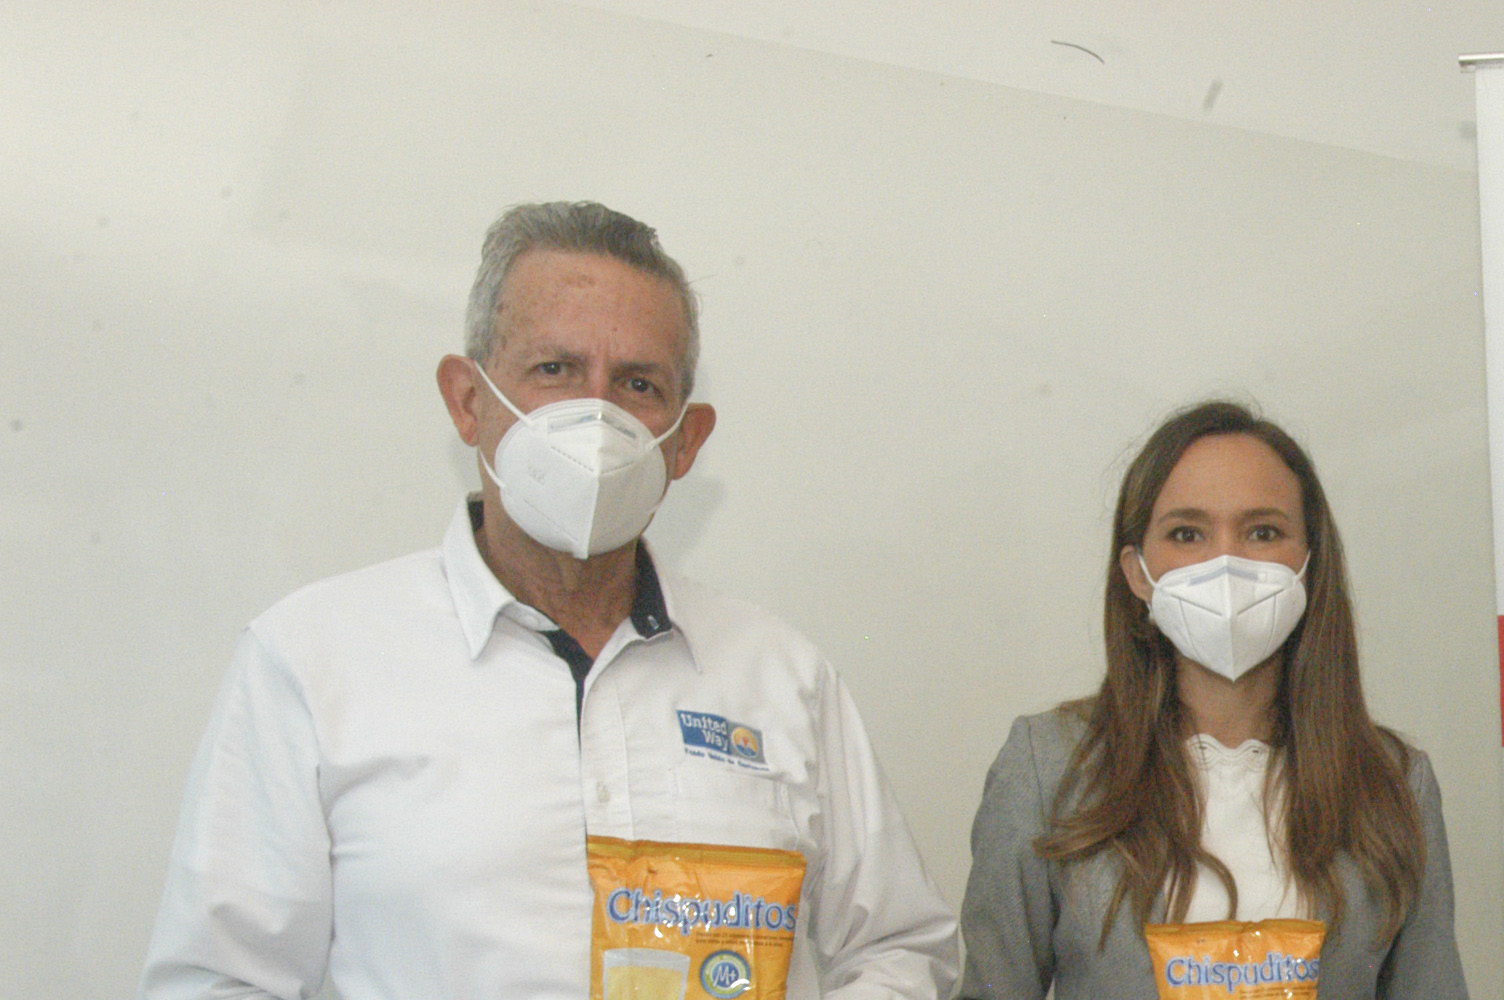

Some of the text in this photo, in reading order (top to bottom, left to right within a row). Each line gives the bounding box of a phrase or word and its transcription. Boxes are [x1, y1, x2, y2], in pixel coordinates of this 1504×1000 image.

[681, 713, 727, 735] United
[702, 728, 728, 751] Way
[608, 888, 796, 934] Chispuditos
[1167, 953, 1319, 992] Chispuditos
